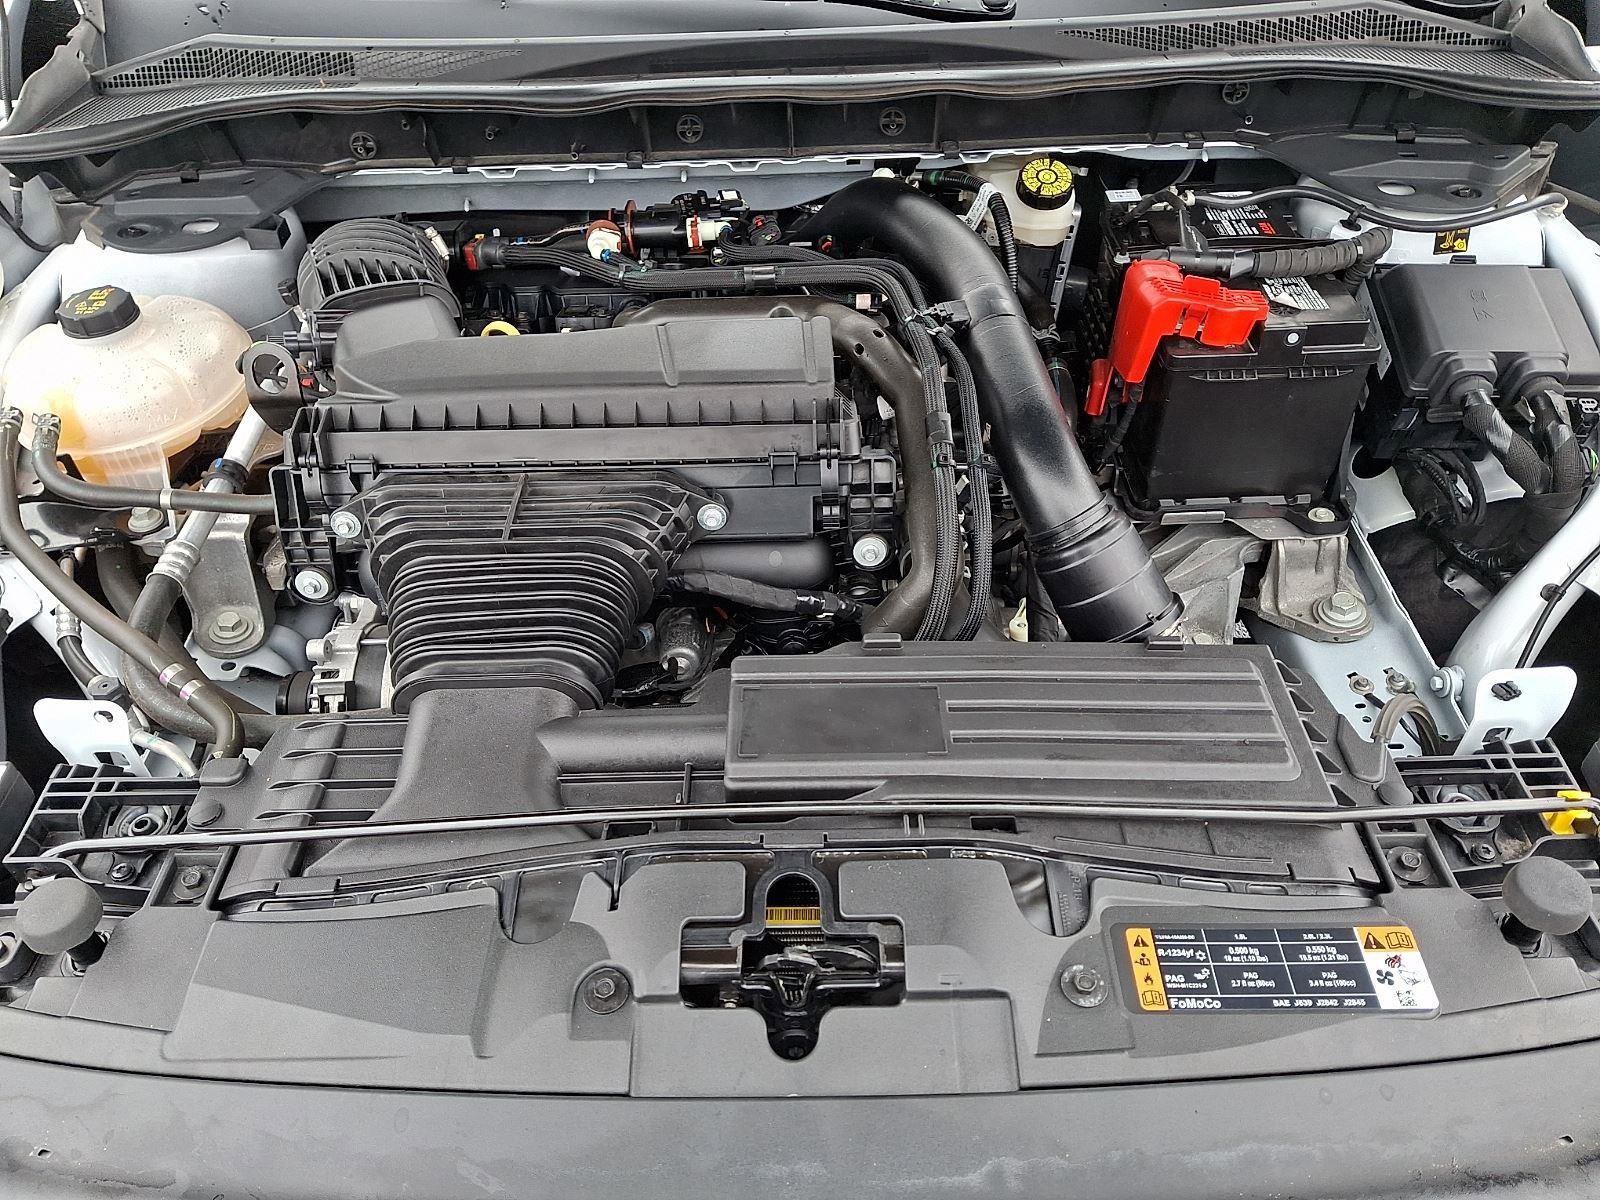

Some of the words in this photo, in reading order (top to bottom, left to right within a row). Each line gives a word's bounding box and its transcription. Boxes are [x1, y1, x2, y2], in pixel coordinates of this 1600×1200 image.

[1158, 949, 1194, 958] R-1234yf
[1229, 947, 1248, 955] 0.500
[1249, 947, 1260, 956] kg
[1306, 946, 1325, 954] 0.550
[1326, 946, 1337, 955] kg
[1166, 975, 1186, 983] PAG
[1243, 972, 1259, 980] PAG
[1170, 998, 1222, 1009] FoMoCo
[1273, 999, 1291, 1007] SAE
